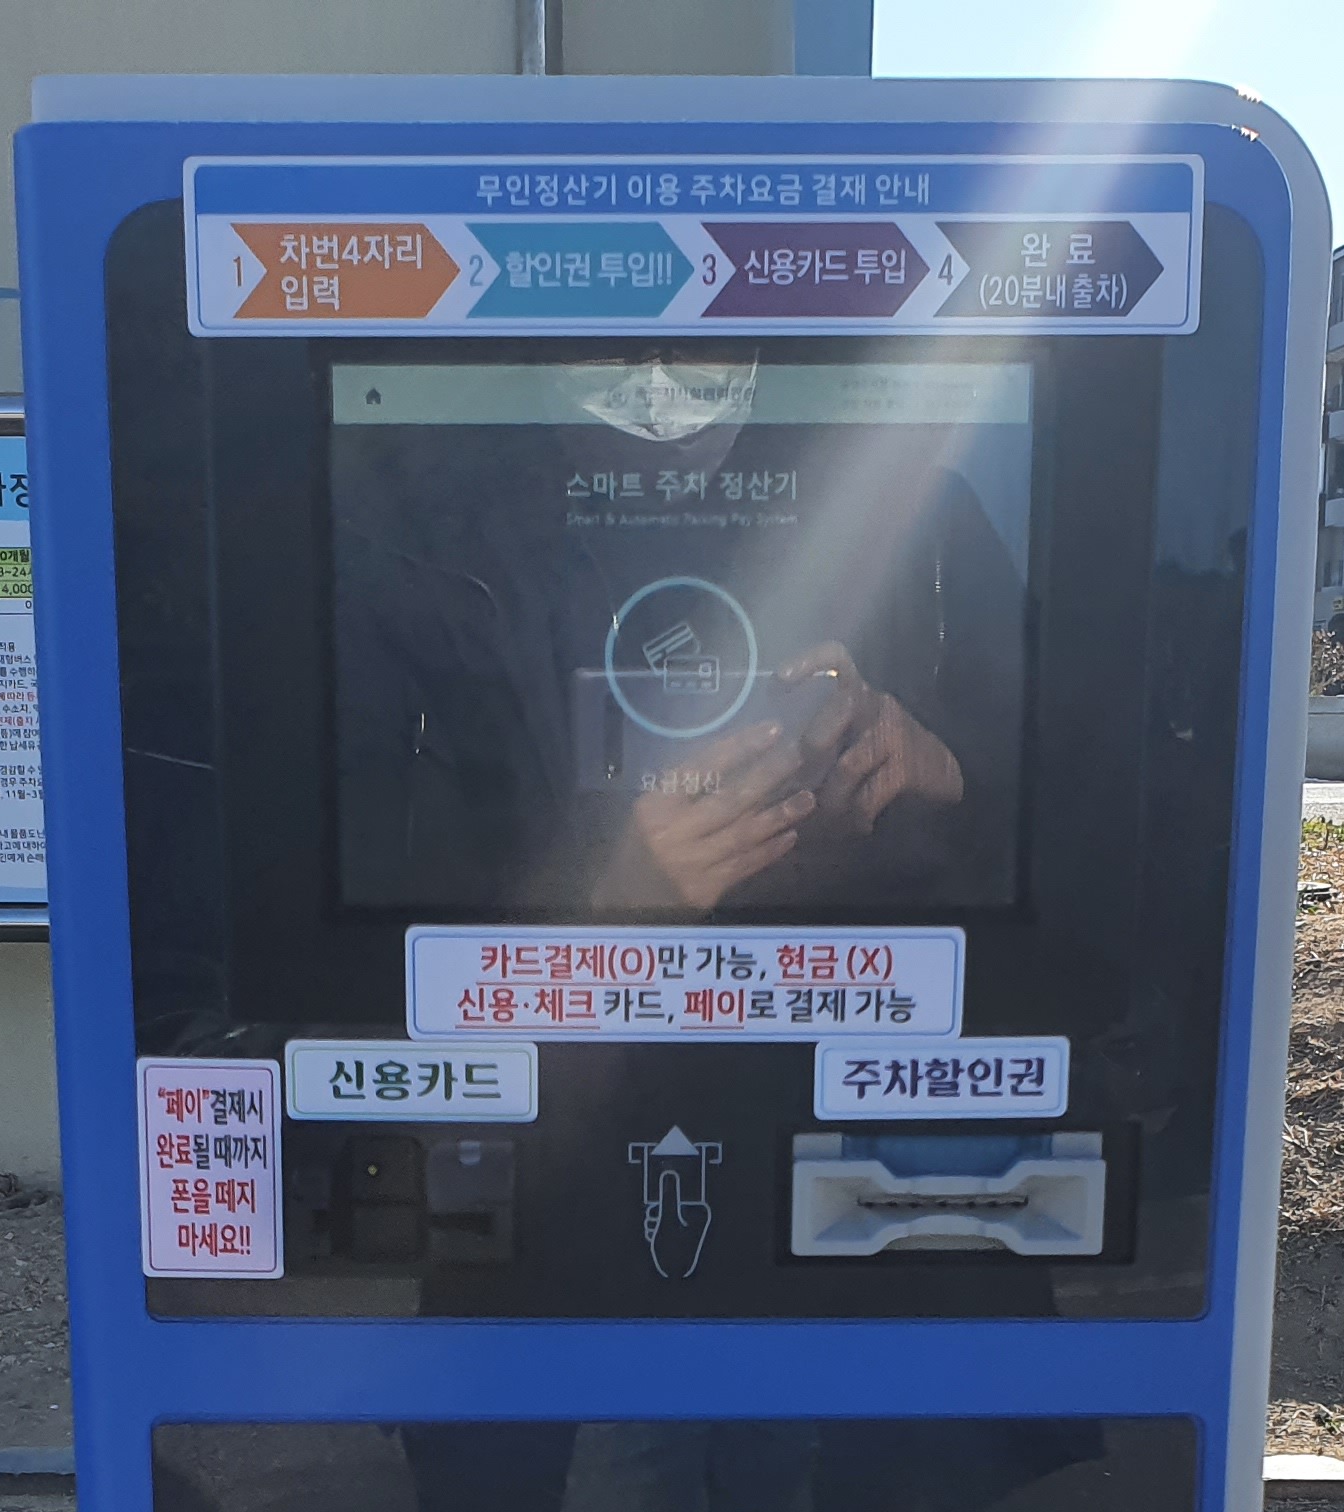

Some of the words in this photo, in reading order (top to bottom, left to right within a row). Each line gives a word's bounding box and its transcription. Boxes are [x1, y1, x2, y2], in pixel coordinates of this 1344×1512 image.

[476, 173, 618, 206] 무인정산기
[627, 173, 681, 206] 이용
[689, 173, 803, 206] 주차요금
[811, 173, 865, 206] 결재
[875, 173, 930, 206] 안내
[279, 233, 424, 270] 차번4자리
[505, 251, 592, 289] 할인권
[597, 250, 673, 288] 투입!!
[701, 254, 717, 286] 3
[744, 249, 852, 286] 신용카드
[854, 249, 907, 285] 투입
[938, 254, 954, 286] 4
[232, 255, 244, 287] 1
[469, 254, 484, 287] 2
[279, 275, 341, 312] 입력
[566, 471, 645, 501] 스마트
[657, 471, 708, 501] 주차
[720, 471, 797, 501] 정산기
[696, 945, 767, 982] 가능,
[775, 944, 839, 980] 현금
[845, 945, 894, 979] (X)
[457, 987, 597, 1024] 신용·체크
[603, 989, 675, 1026] 카드,
[683, 988, 779, 1024] 페이로
[784, 988, 849, 1025] 결제
[854, 987, 917, 1024] 가능
[329, 1059, 502, 1101] 신용카드
[841, 1057, 1048, 1099] 주차할인권
[157, 1133, 211, 1170] 완료될
[214, 1134, 267, 1170] 때까지
[171, 1178, 211, 1214] 폰을
[215, 1178, 256, 1213] 떼지
[178, 1222, 250, 1257] 마세요!!
